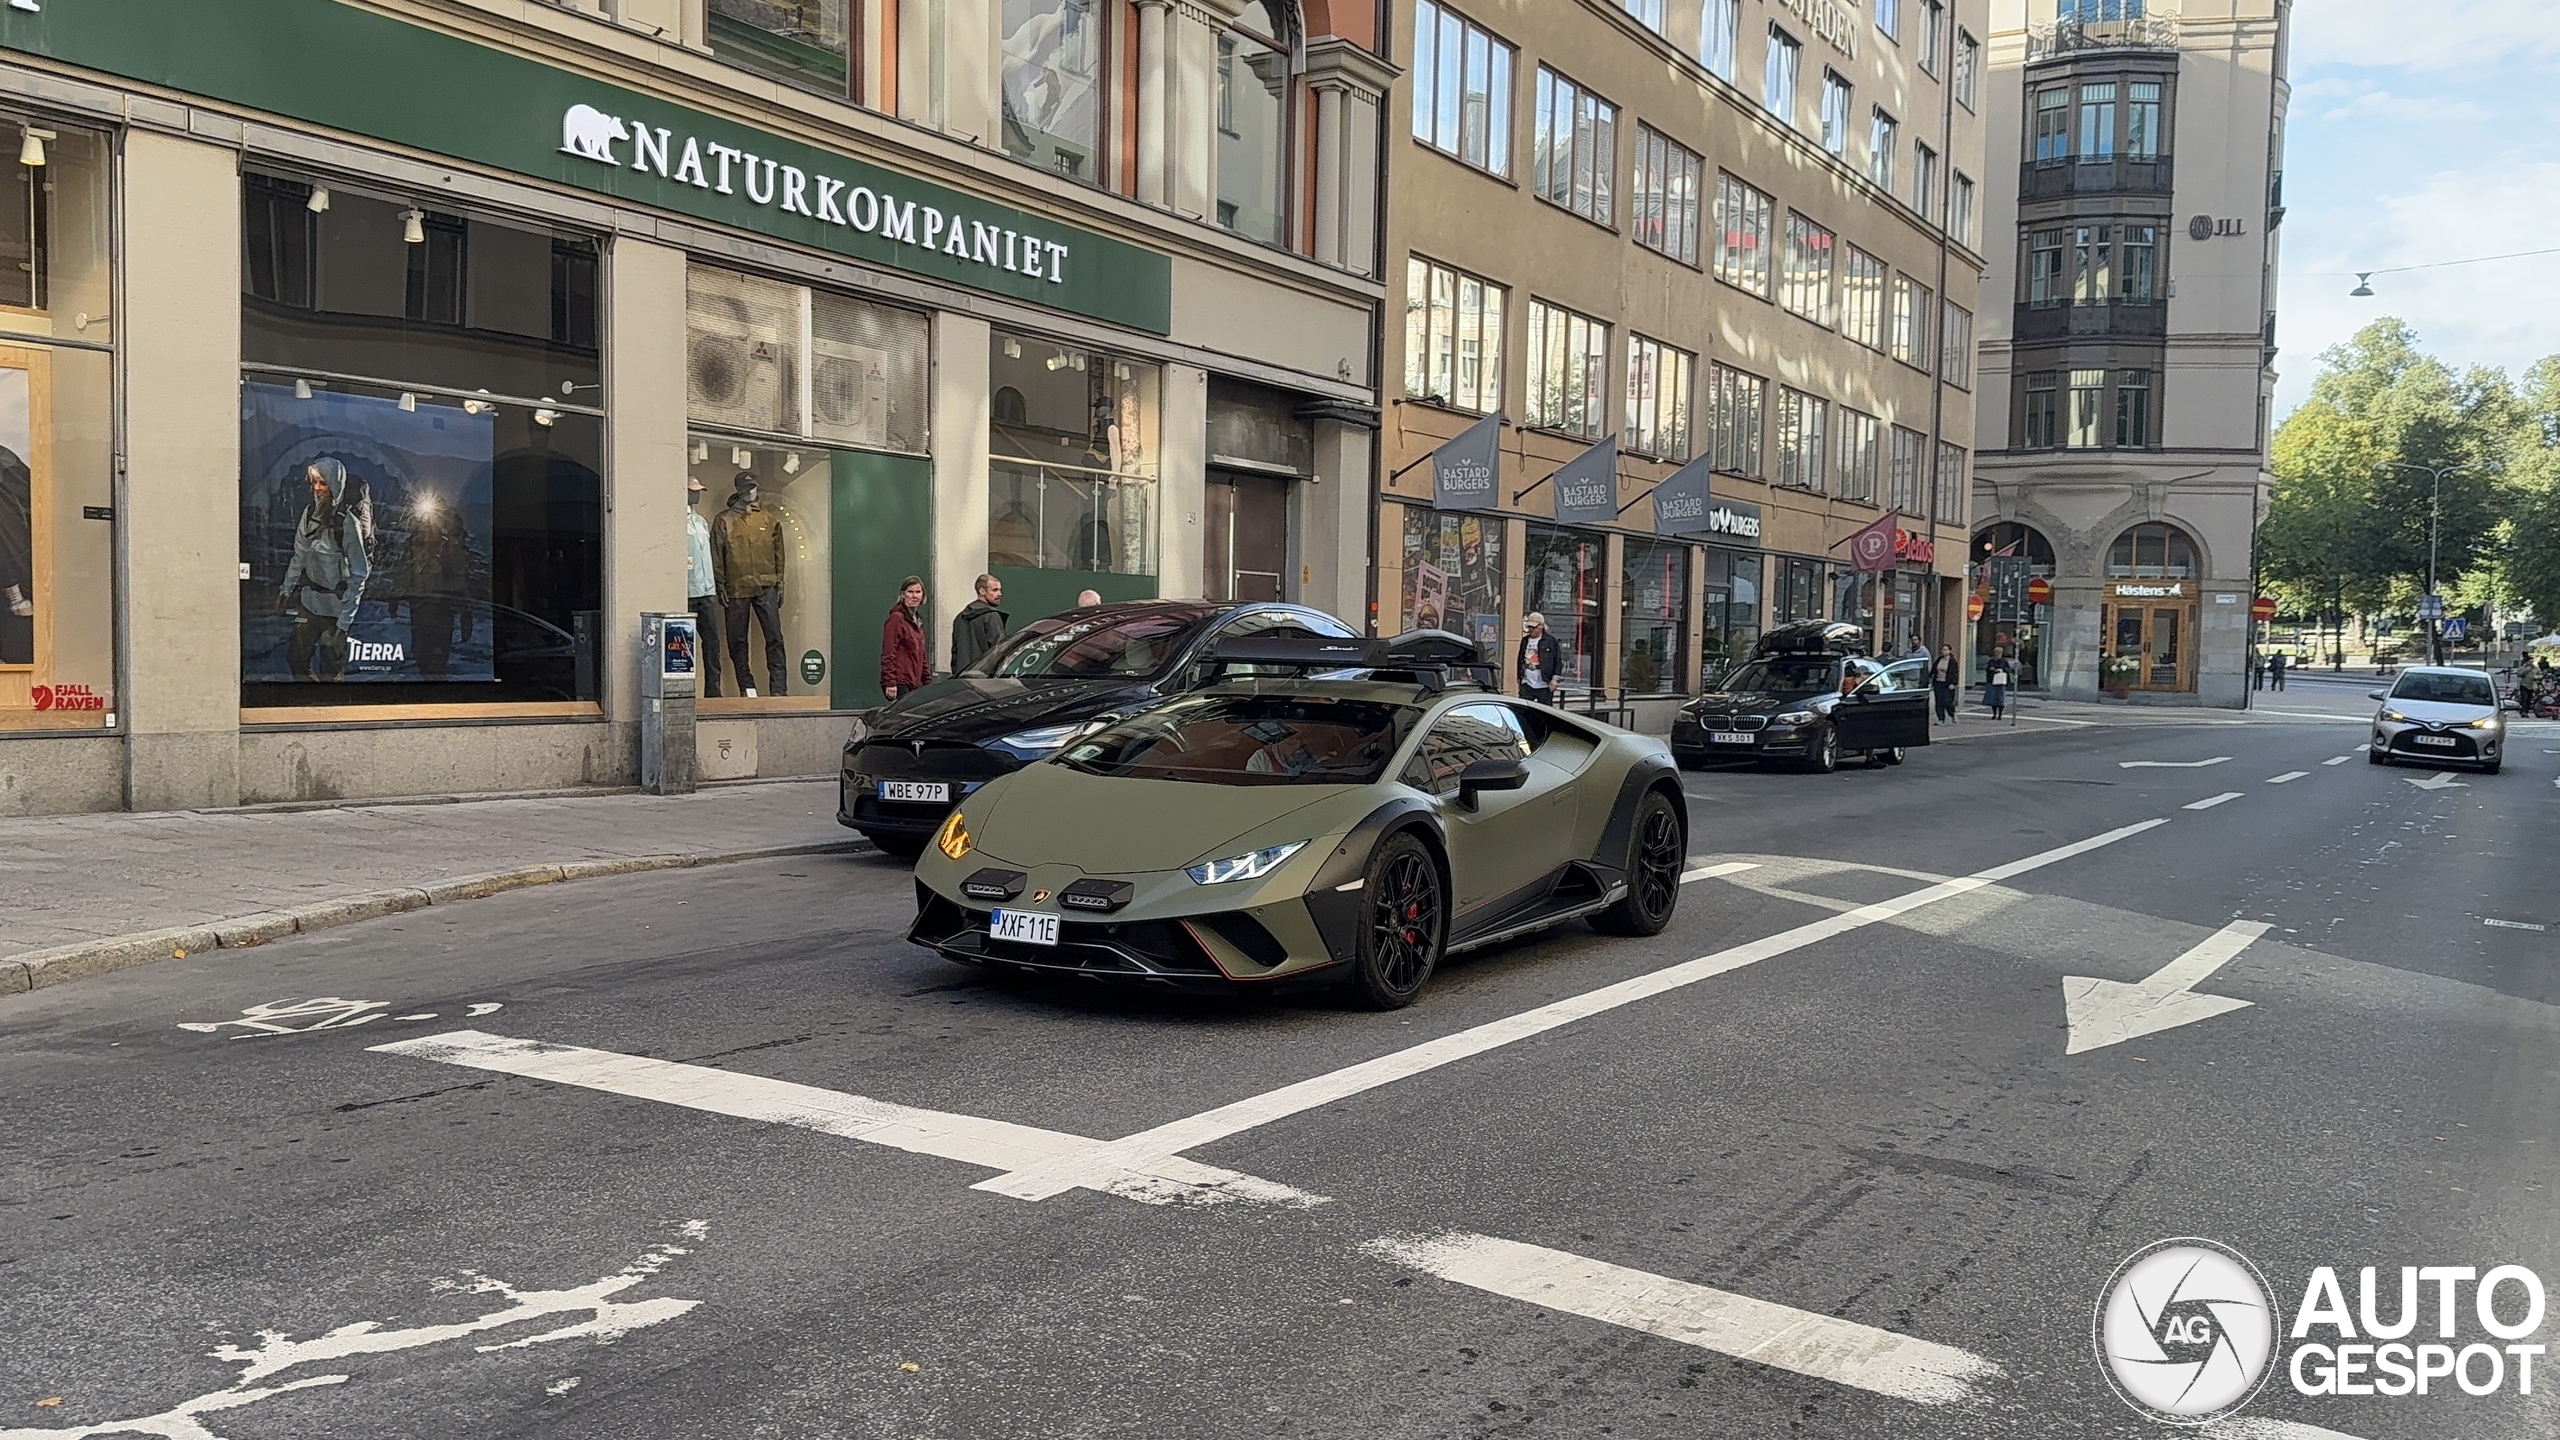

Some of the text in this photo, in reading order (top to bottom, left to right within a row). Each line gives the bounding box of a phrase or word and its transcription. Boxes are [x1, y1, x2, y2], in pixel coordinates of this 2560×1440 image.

[630, 120, 1068, 284] NATURKOMPANIET
[2214, 218, 2247, 236] JLL
[1443, 467, 1490, 479] BASTARD
[1443, 477, 1490, 491] BURGERS
[1563, 485, 1607, 497] BASTARD
[1563, 494, 1607, 507] BURGERS
[1662, 498, 1702, 510] BASTARD
[1663, 507, 1703, 519] BURGERS
[1730, 514, 1760, 537] BURGERS
[2115, 584, 2164, 596] Hästens
[55, 683, 93, 696] FJÄLL
[1717, 734, 1751, 742] XKS 301
[888, 783, 943, 799] WBE 97P
[999, 912, 1056, 942] XXF11E
